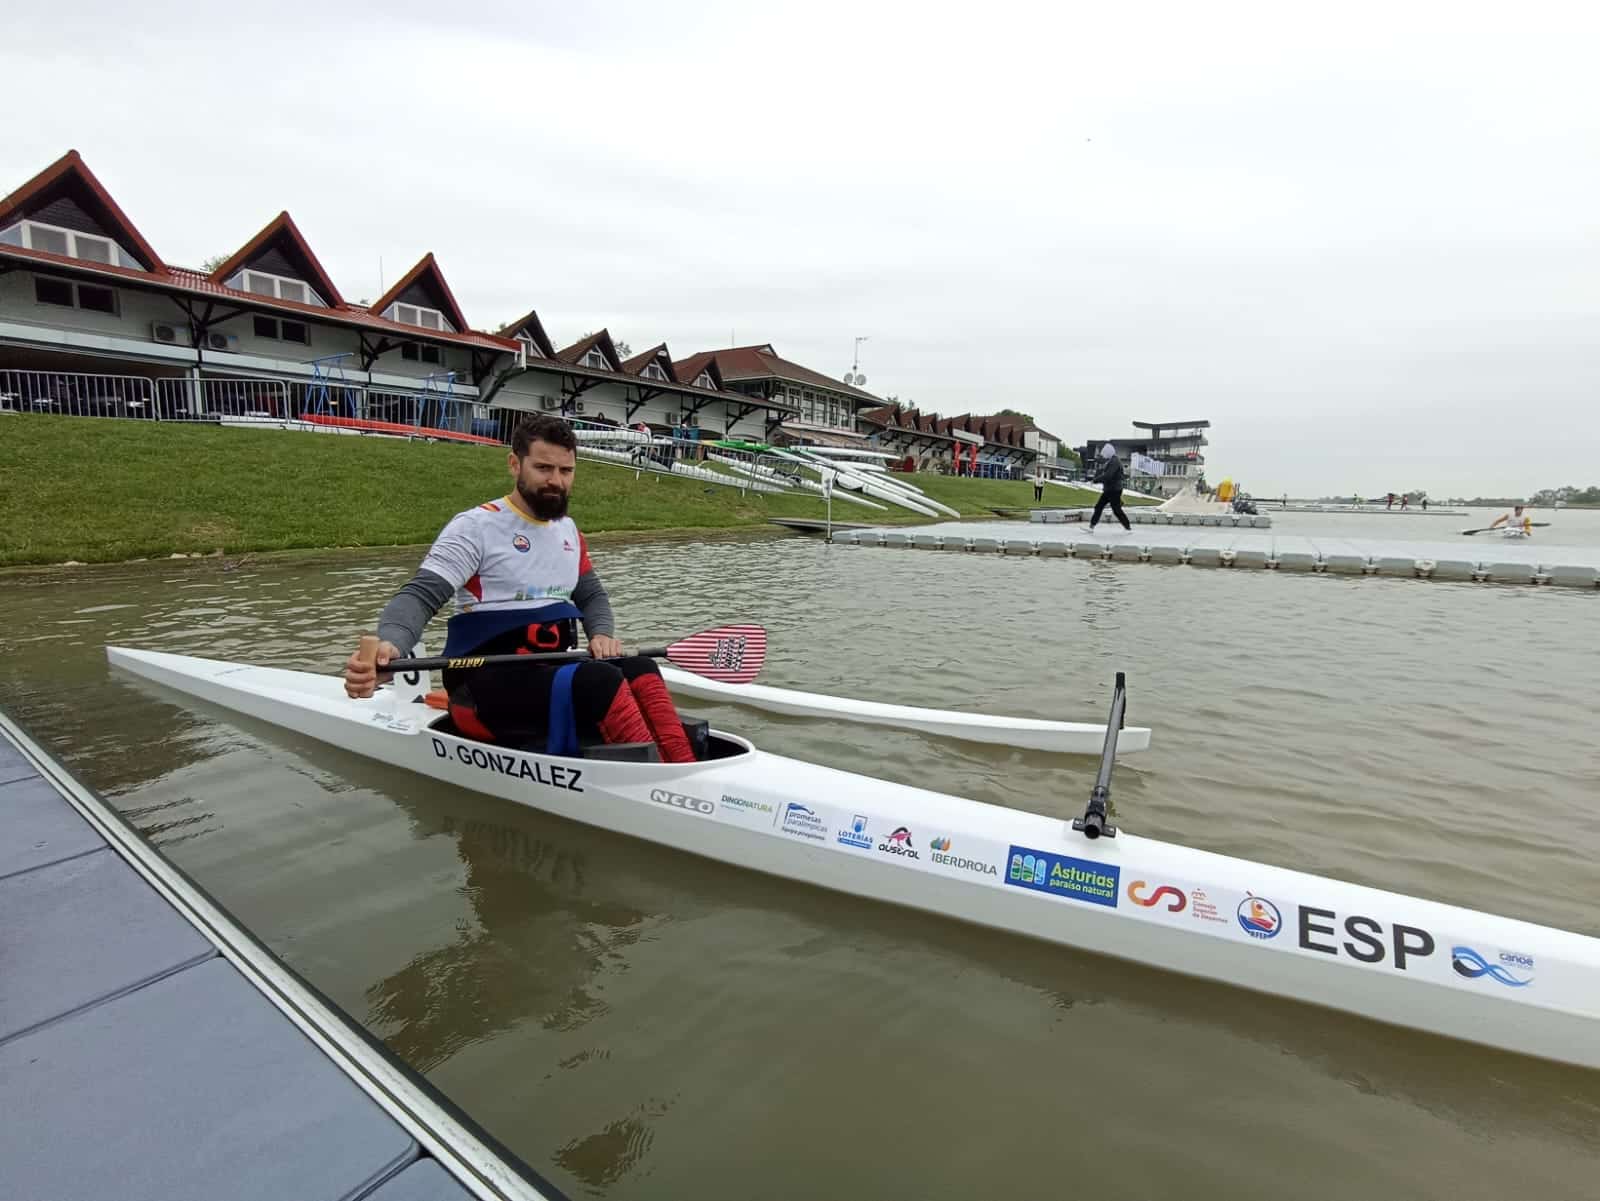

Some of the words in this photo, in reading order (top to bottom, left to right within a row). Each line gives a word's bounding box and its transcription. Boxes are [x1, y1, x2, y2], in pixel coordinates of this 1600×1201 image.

[431, 737, 453, 760] D.
[456, 745, 584, 792] GONZALEZ
[931, 852, 997, 875] IBERDROLA
[1051, 862, 1115, 888] Asturias
[1082, 885, 1113, 898] natural
[1297, 904, 1435, 970] ESP
